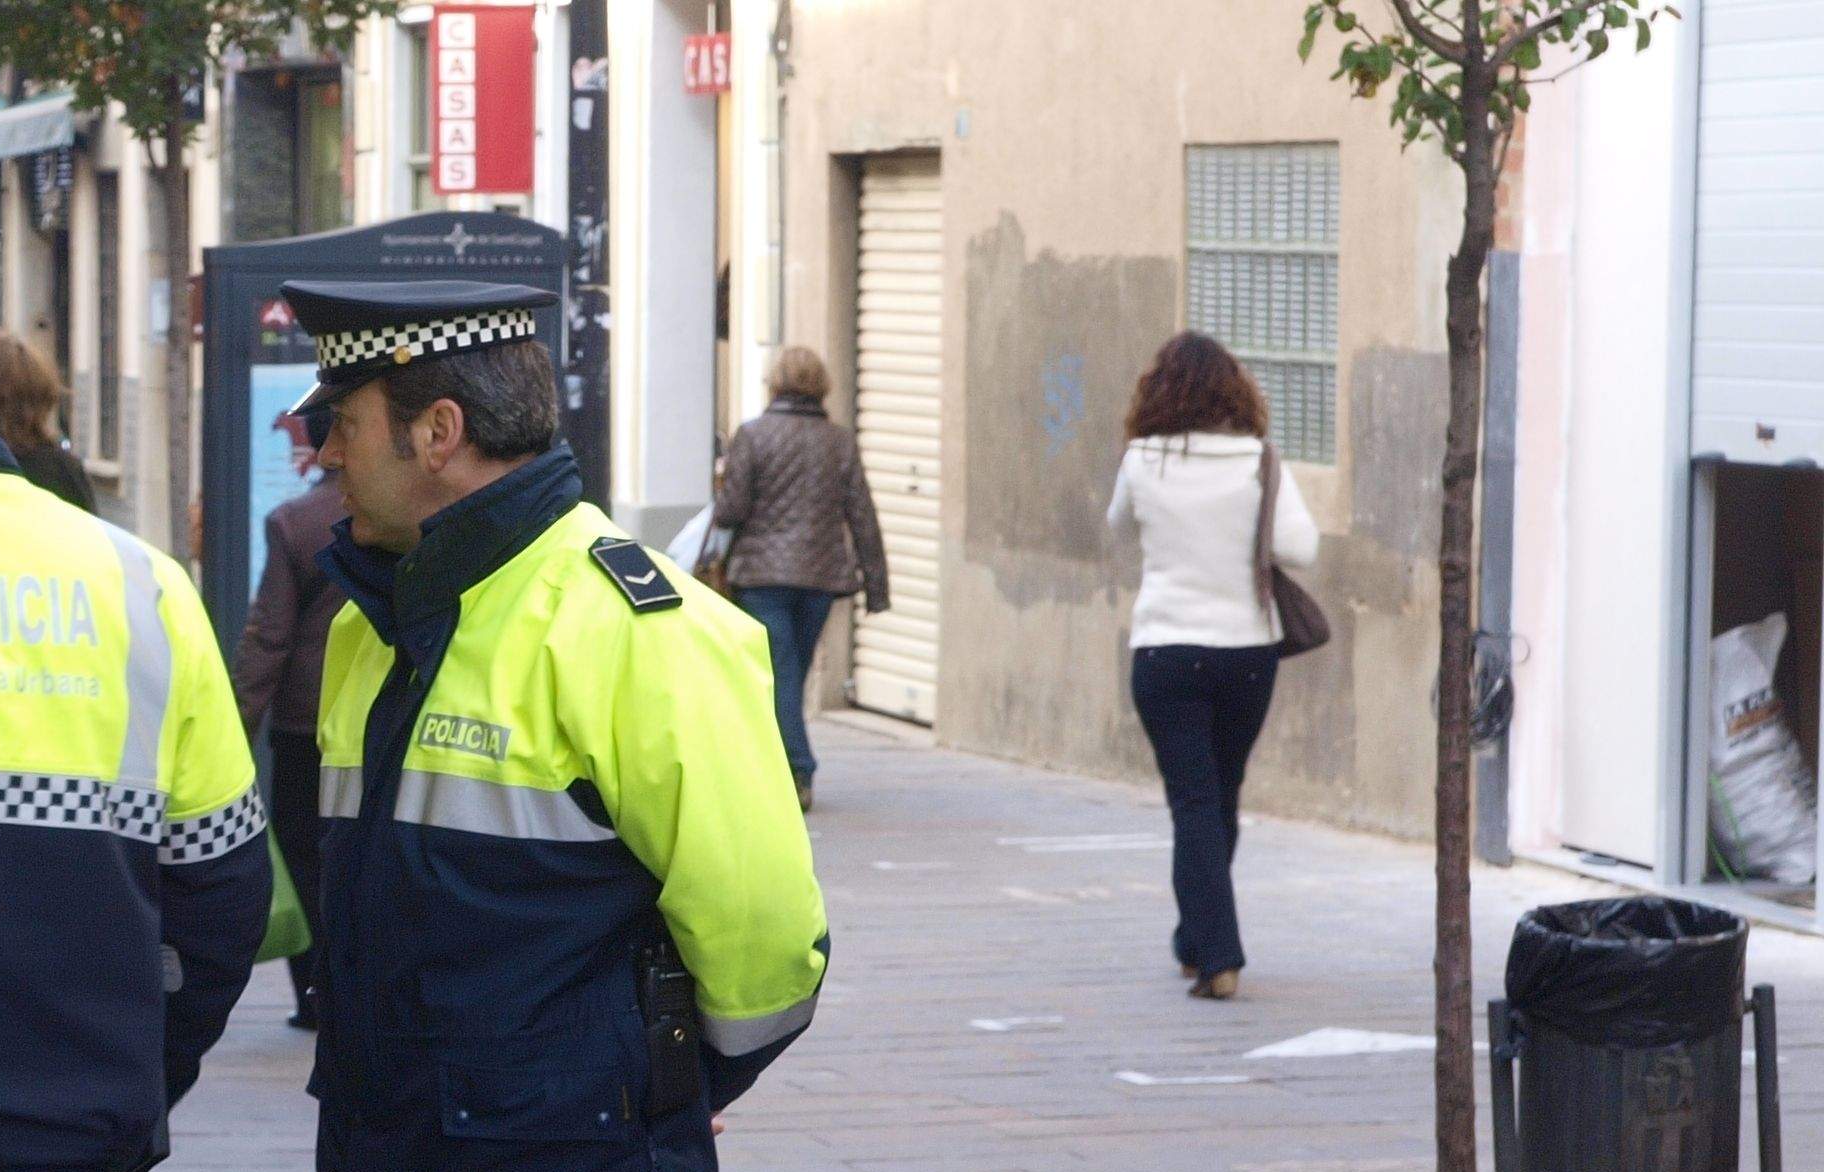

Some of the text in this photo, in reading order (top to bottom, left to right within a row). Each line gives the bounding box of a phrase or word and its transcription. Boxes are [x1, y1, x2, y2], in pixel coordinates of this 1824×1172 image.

[684, 42, 728, 88] CAS
[447, 19, 467, 183] CASAS
[14, 667, 101, 698] Urbana
[423, 717, 501, 756] POLICIA
